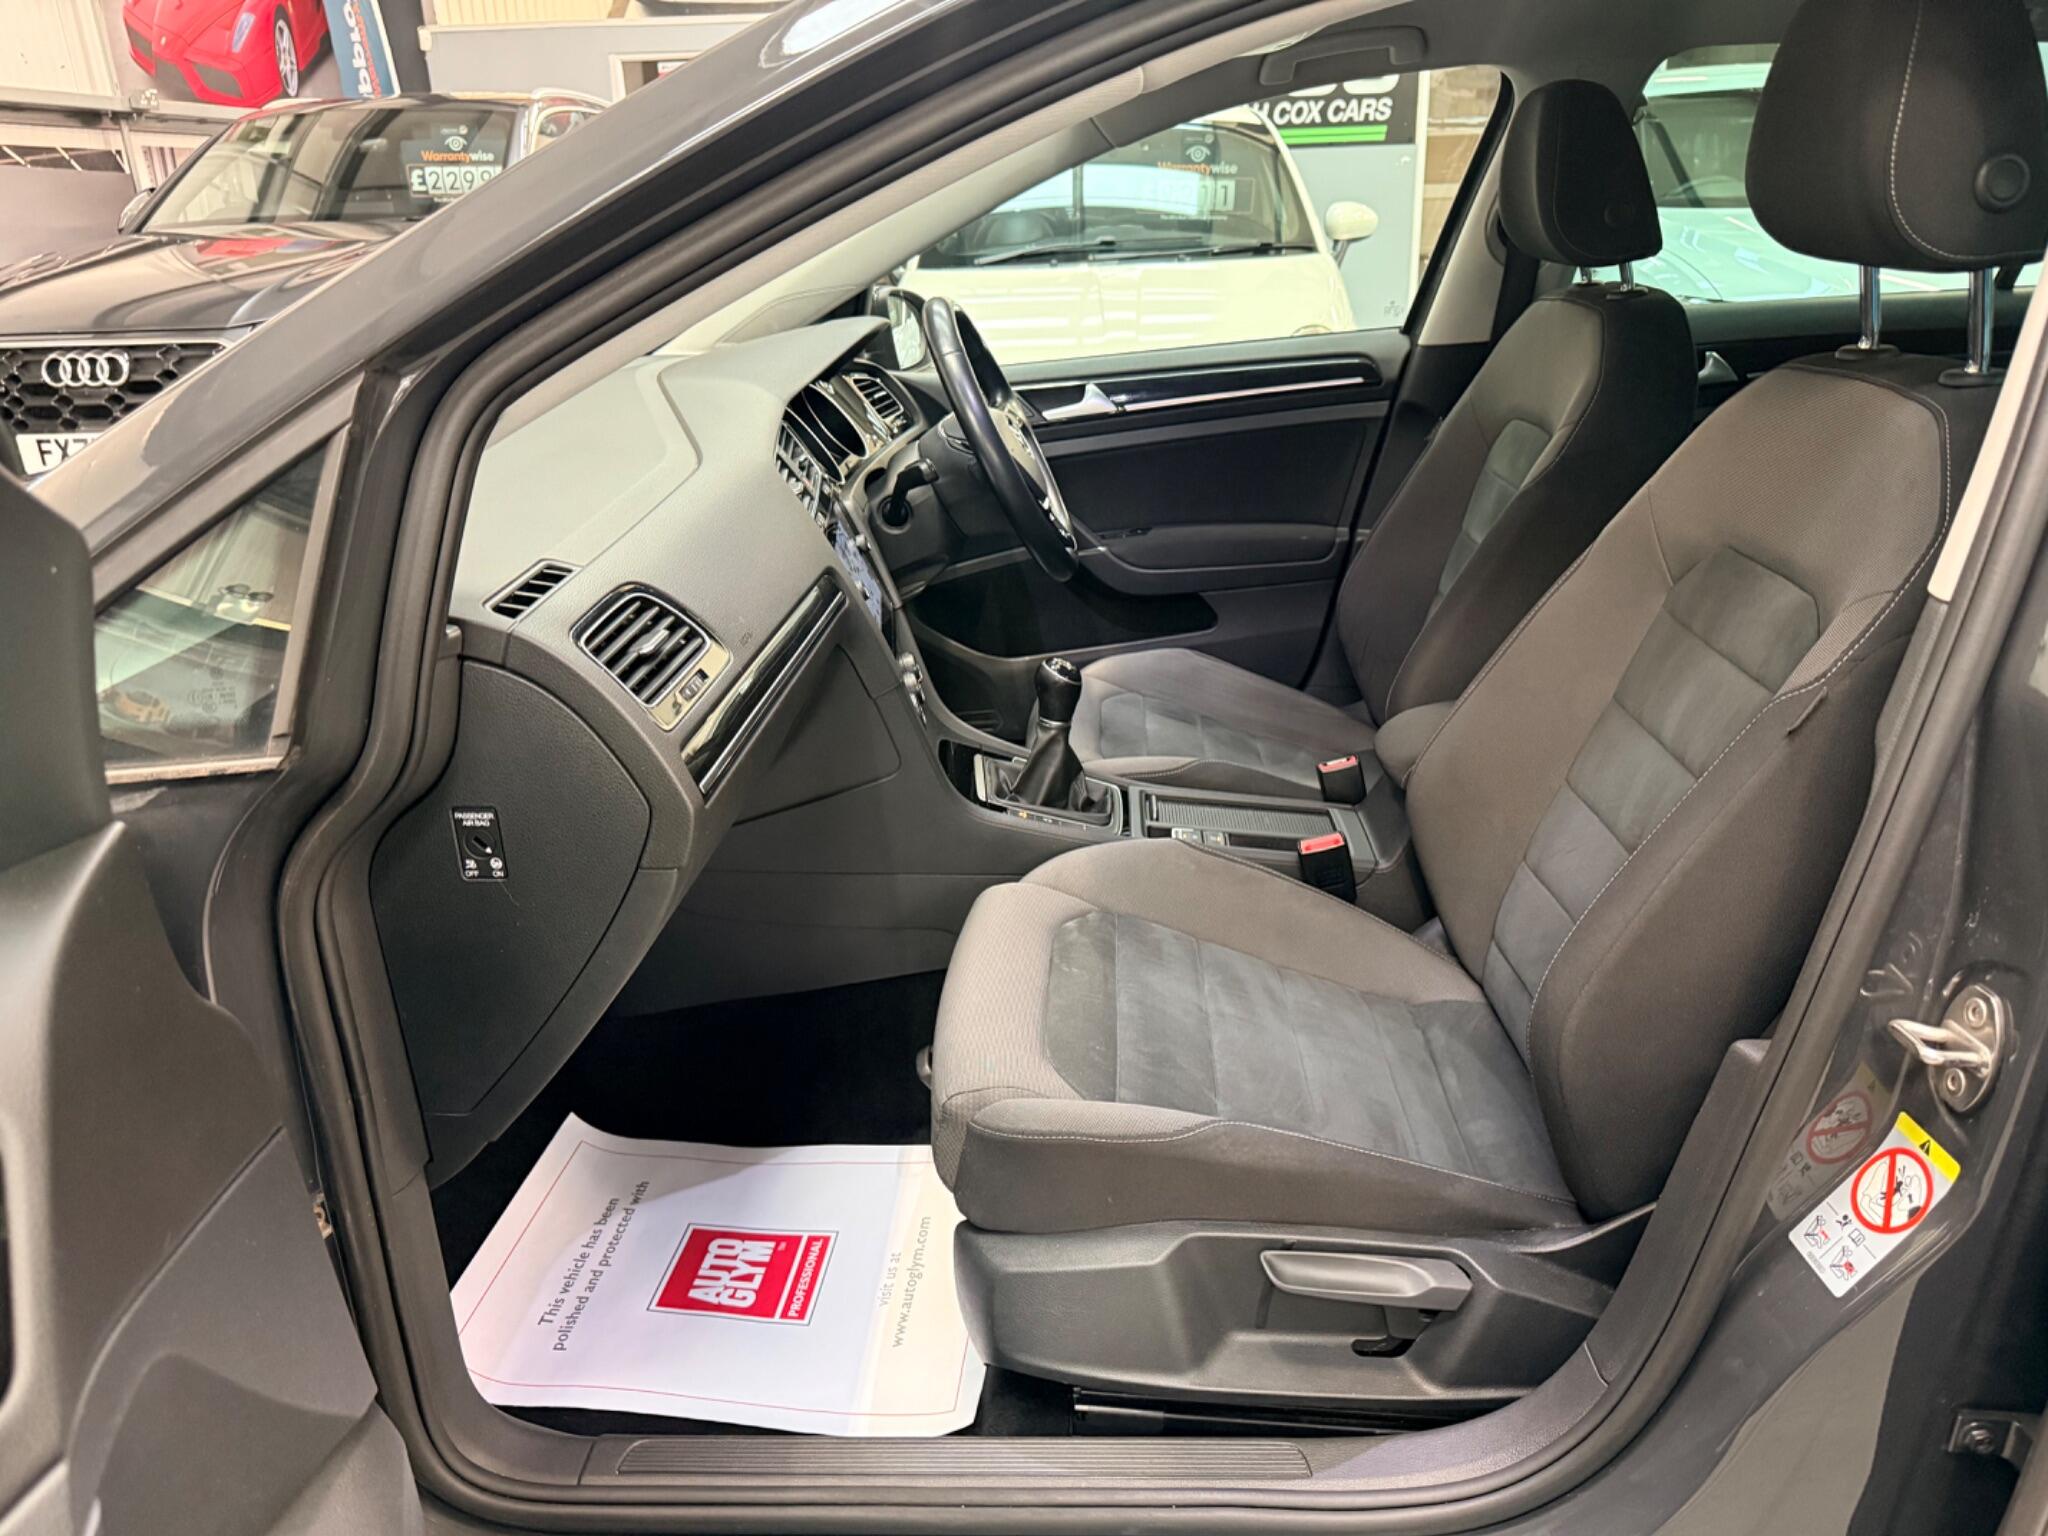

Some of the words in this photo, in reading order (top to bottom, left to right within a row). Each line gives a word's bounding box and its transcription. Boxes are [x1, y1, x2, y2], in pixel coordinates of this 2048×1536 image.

[1272, 99, 1326, 125] COX
[1326, 96, 1393, 123] CARS
[410, 168, 493, 191] £2299
[421, 149, 495, 163] Warrantywise
[538, 1297, 565, 1326] This
[560, 1251, 590, 1295] vehicle
[581, 1228, 603, 1250] has
[593, 1197, 621, 1226] been
[553, 1295, 590, 1351] polished
[584, 1269, 604, 1294] and
[598, 1207, 636, 1268] protected
[630, 1180, 650, 1206] with
[687, 1237, 744, 1305] AUTO
[717, 1239, 776, 1309] GLYM
[786, 1238, 824, 1318] PROFESSIONAL
[886, 1266, 898, 1281] us
[890, 1251, 902, 1264] at
[892, 1216, 932, 1348] www.autoglym.com
